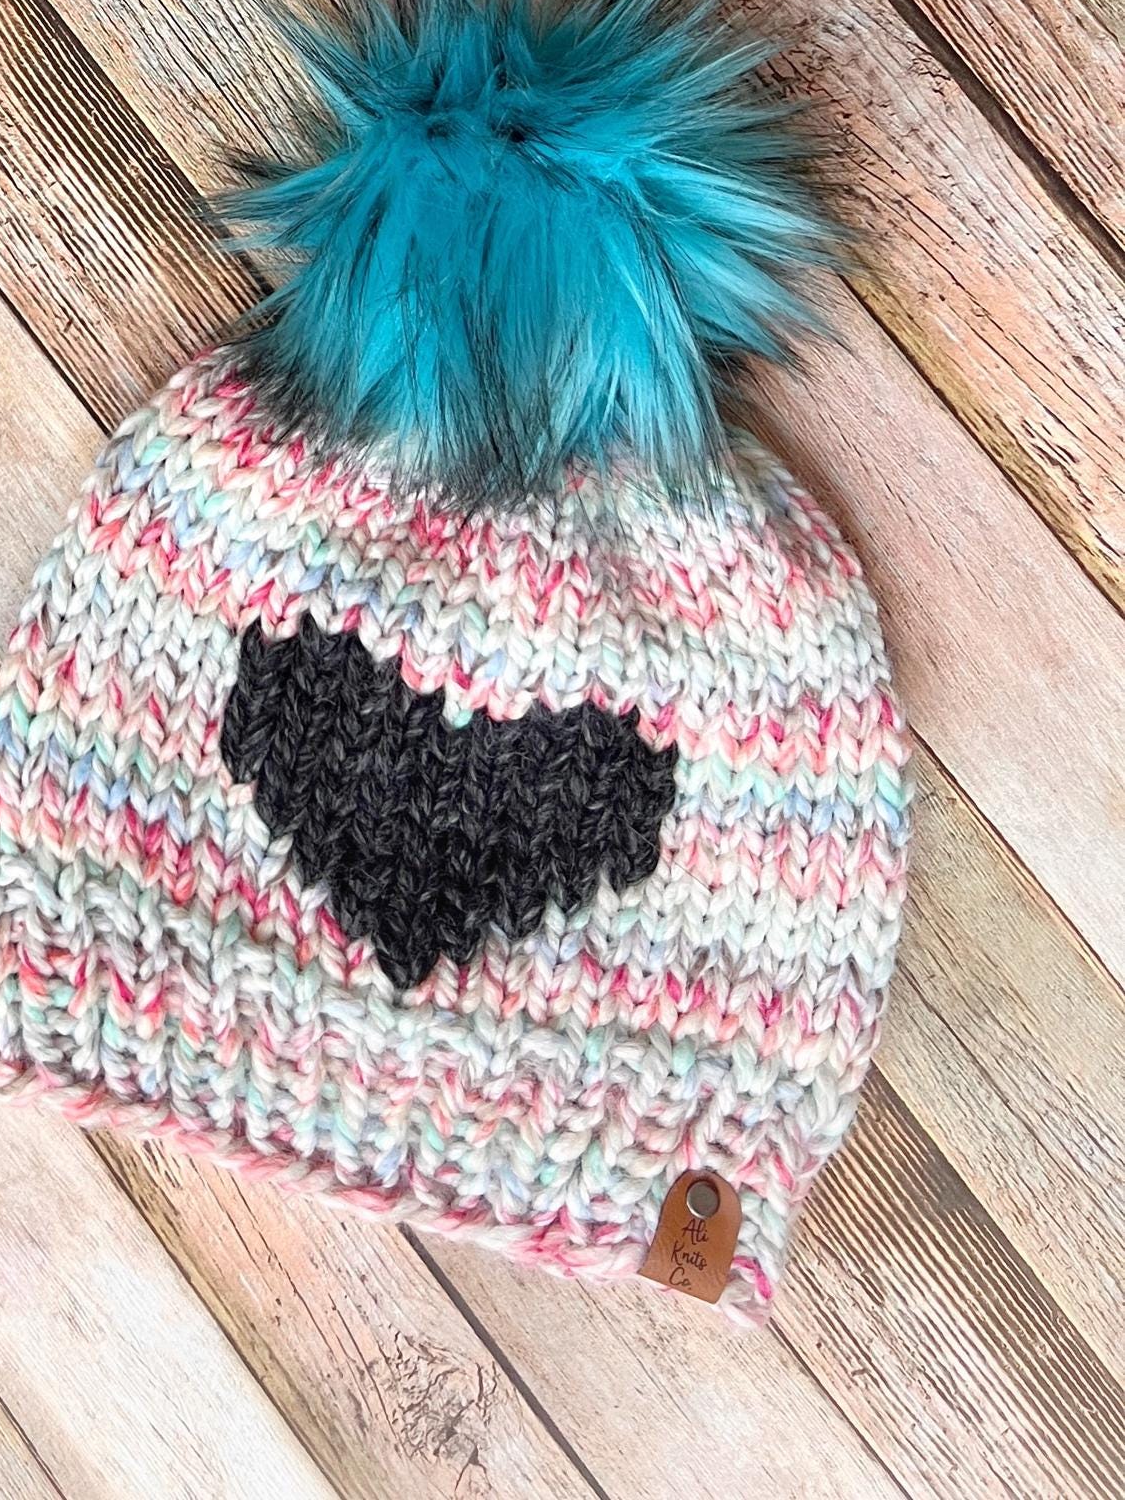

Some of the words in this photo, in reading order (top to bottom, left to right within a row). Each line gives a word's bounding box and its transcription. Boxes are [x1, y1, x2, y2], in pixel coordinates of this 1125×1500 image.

[681, 1218, 709, 1245] Ali
[670, 1240, 708, 1271] Knits
[668, 1266, 693, 1291] Co.
